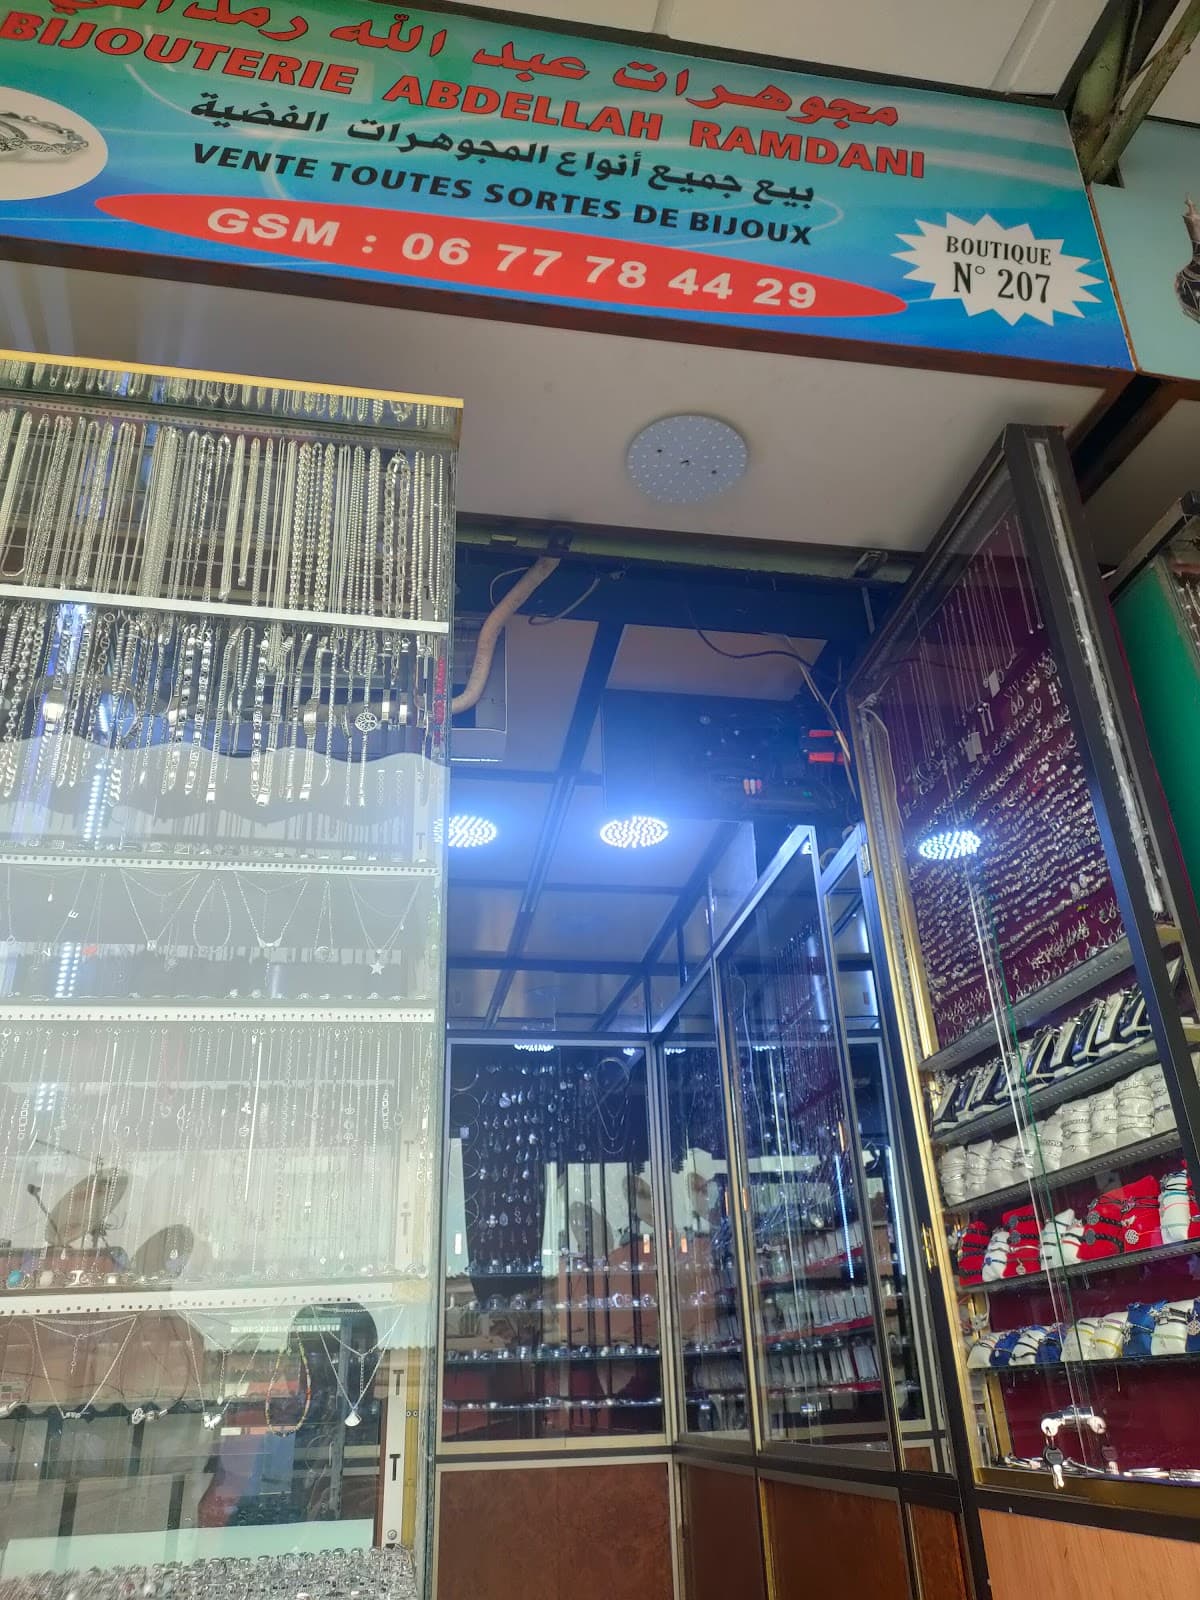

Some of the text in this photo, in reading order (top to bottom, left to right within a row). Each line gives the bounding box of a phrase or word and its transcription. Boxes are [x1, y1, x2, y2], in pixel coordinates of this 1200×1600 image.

[0, 11, 925, 179] BIJOUTERIE ABDELLAH RAMDANI
[472, 41, 590, 82] عبد
[613, 61, 899, 130] مجوهرات
[190, 92, 814, 209] بيع جميع أنواع المجوهرات الفضية
[193, 142, 812, 245] VENTE TOUTES SORTES DE BIJOUX
[207, 208, 340, 247] GSM
[402, 233, 471, 265] 06
[496, 244, 562, 277] 77
[585, 256, 647, 289] 78
[668, 268, 733, 300] 44
[753, 278, 816, 309] 29
[946, 235, 1052, 266] BOUTIQUE
[953, 261, 1051, 304] N° 207
